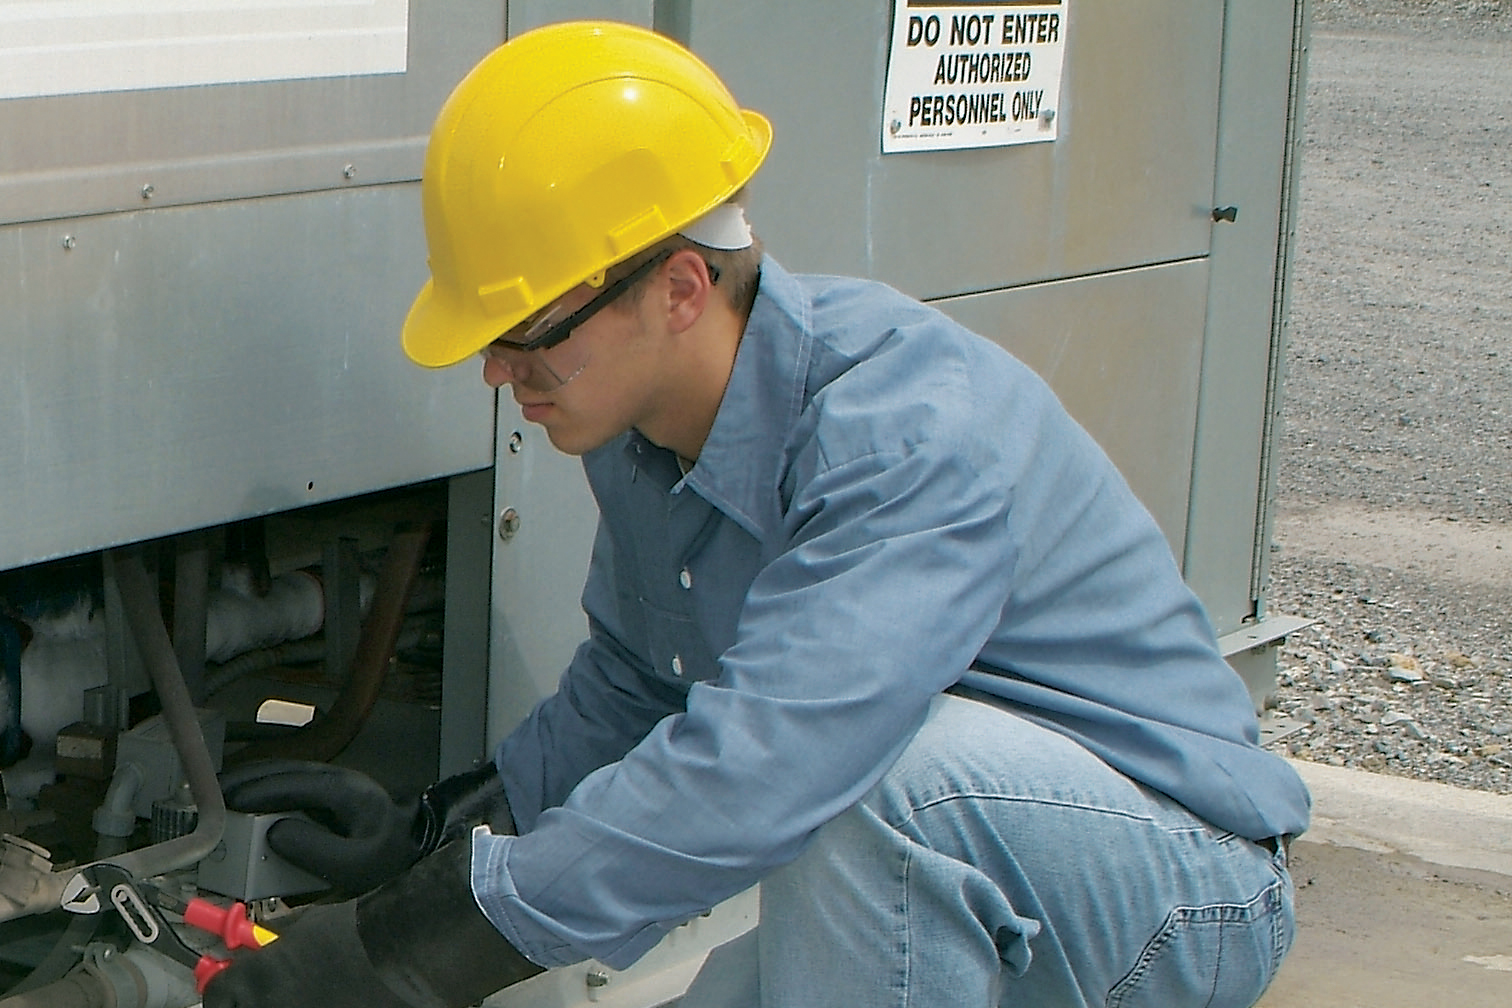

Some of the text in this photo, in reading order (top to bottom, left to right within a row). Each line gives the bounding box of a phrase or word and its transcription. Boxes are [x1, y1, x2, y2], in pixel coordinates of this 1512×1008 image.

[907, 13, 1060, 47] DO NOT ENTER
[934, 52, 1031, 85] AUTHORIZED
[909, 90, 1044, 127] PERSONNEL ONLY
